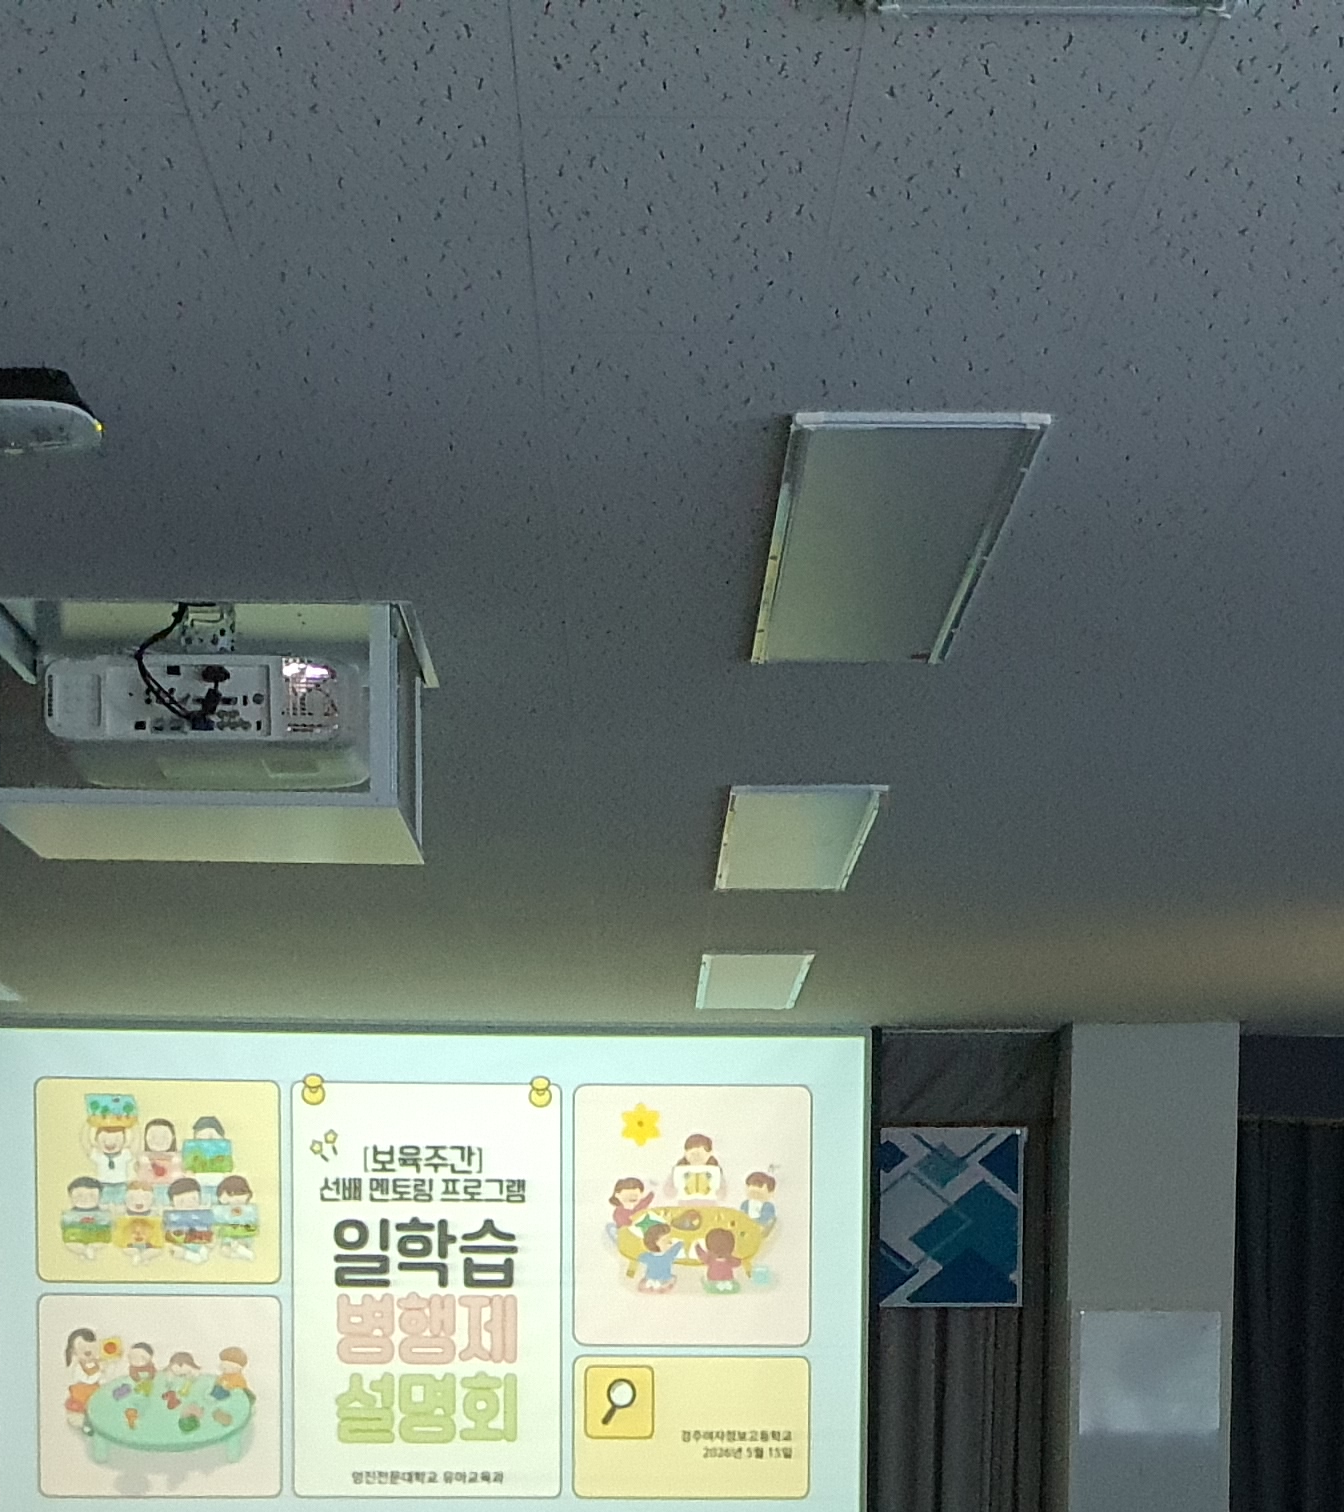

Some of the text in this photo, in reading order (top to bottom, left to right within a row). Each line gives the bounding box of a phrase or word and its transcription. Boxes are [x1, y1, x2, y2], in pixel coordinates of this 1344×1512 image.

[363, 1144, 483, 1174] [보육주간]
[320, 1177, 526, 1203] 선배 멘토링 프로그램
[333, 1217, 519, 1288] 일학습
[336, 1292, 518, 1364] 병행제
[335, 1371, 518, 1443] 설명회
[746, 1445, 764, 1459] 5월
